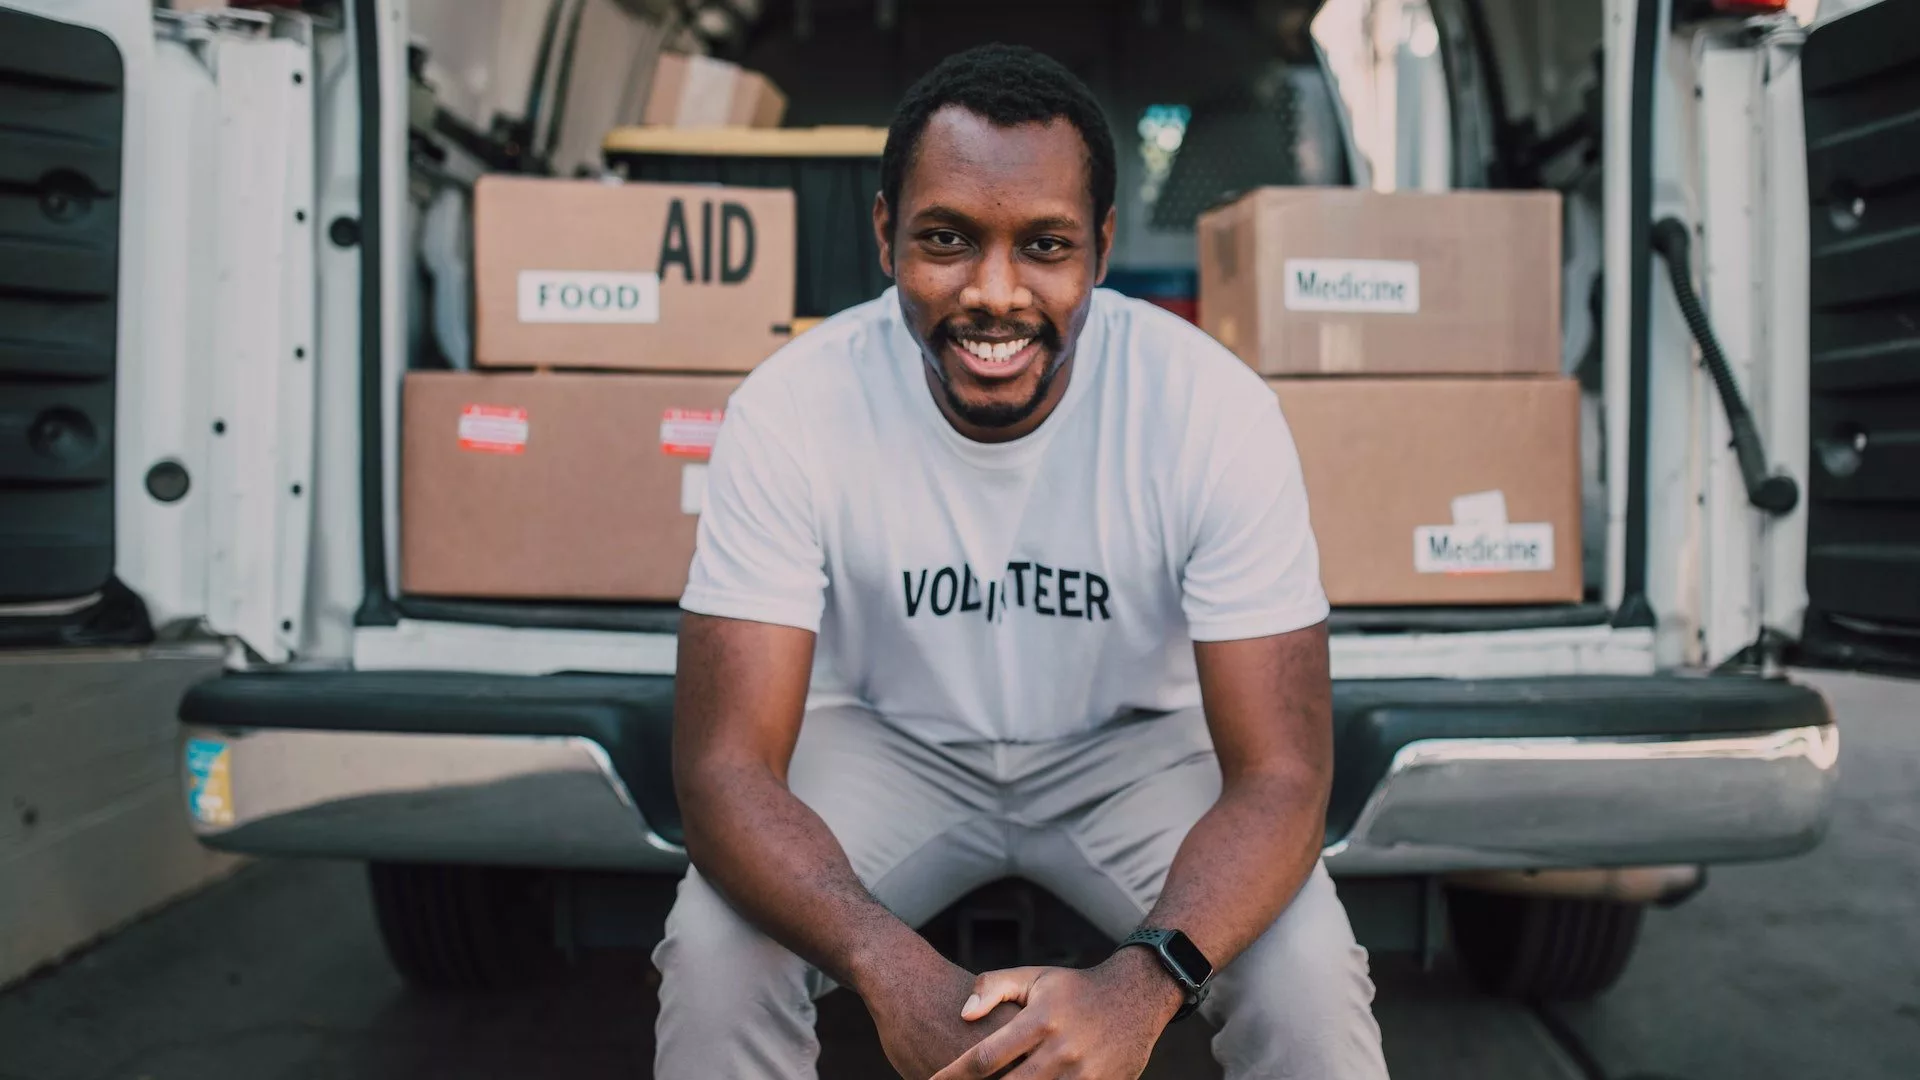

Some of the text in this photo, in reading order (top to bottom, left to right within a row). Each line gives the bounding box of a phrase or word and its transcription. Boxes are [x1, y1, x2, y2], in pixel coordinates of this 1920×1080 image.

[657, 198, 756, 284] AID
[538, 283, 640, 310] FOOD
[1296, 270, 1405, 300] Medicine
[1429, 532, 1538, 562] Medicine
[903, 561, 1111, 622] VOLTEER
